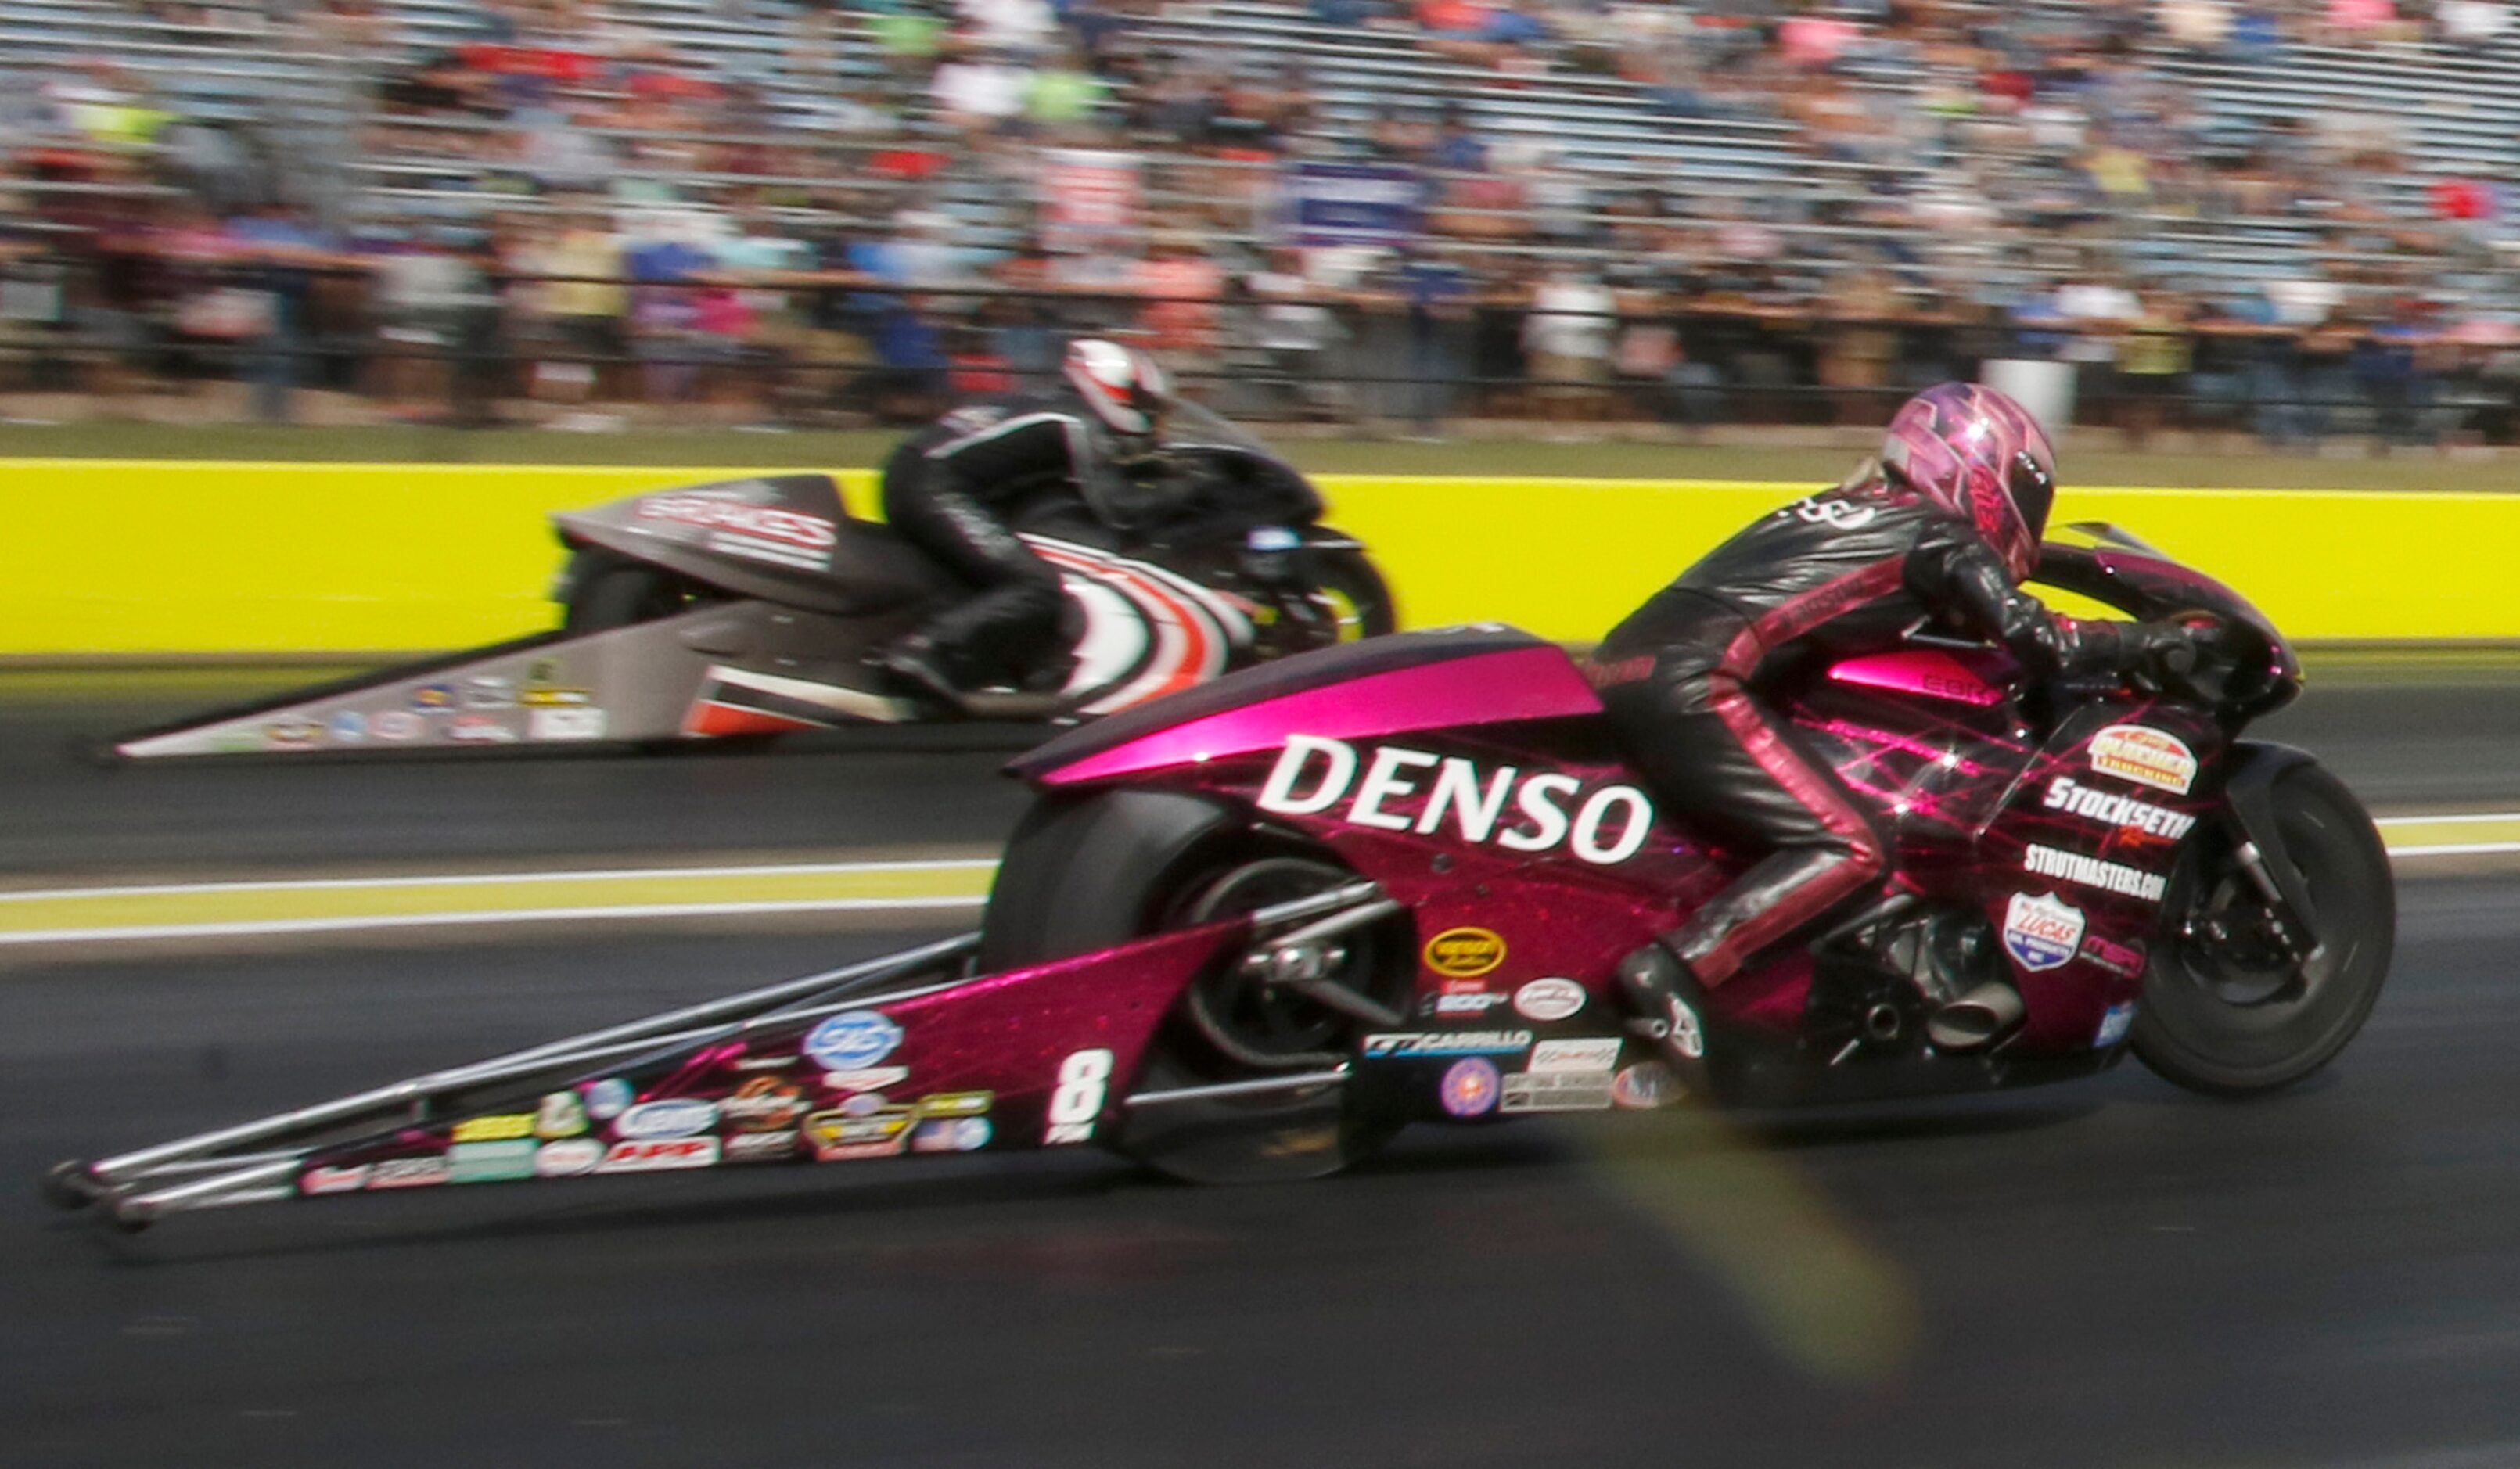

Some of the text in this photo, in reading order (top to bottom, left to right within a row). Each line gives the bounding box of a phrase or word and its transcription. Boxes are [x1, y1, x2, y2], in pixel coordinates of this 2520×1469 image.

[1256, 733, 1654, 864] DENSO
[2043, 776, 2196, 840] STOCKSETH
[2024, 843, 2166, 901] STRUTMASTERS.COM
[2017, 913, 2076, 943] LUCAS
[1048, 1048, 1114, 1124] 8
